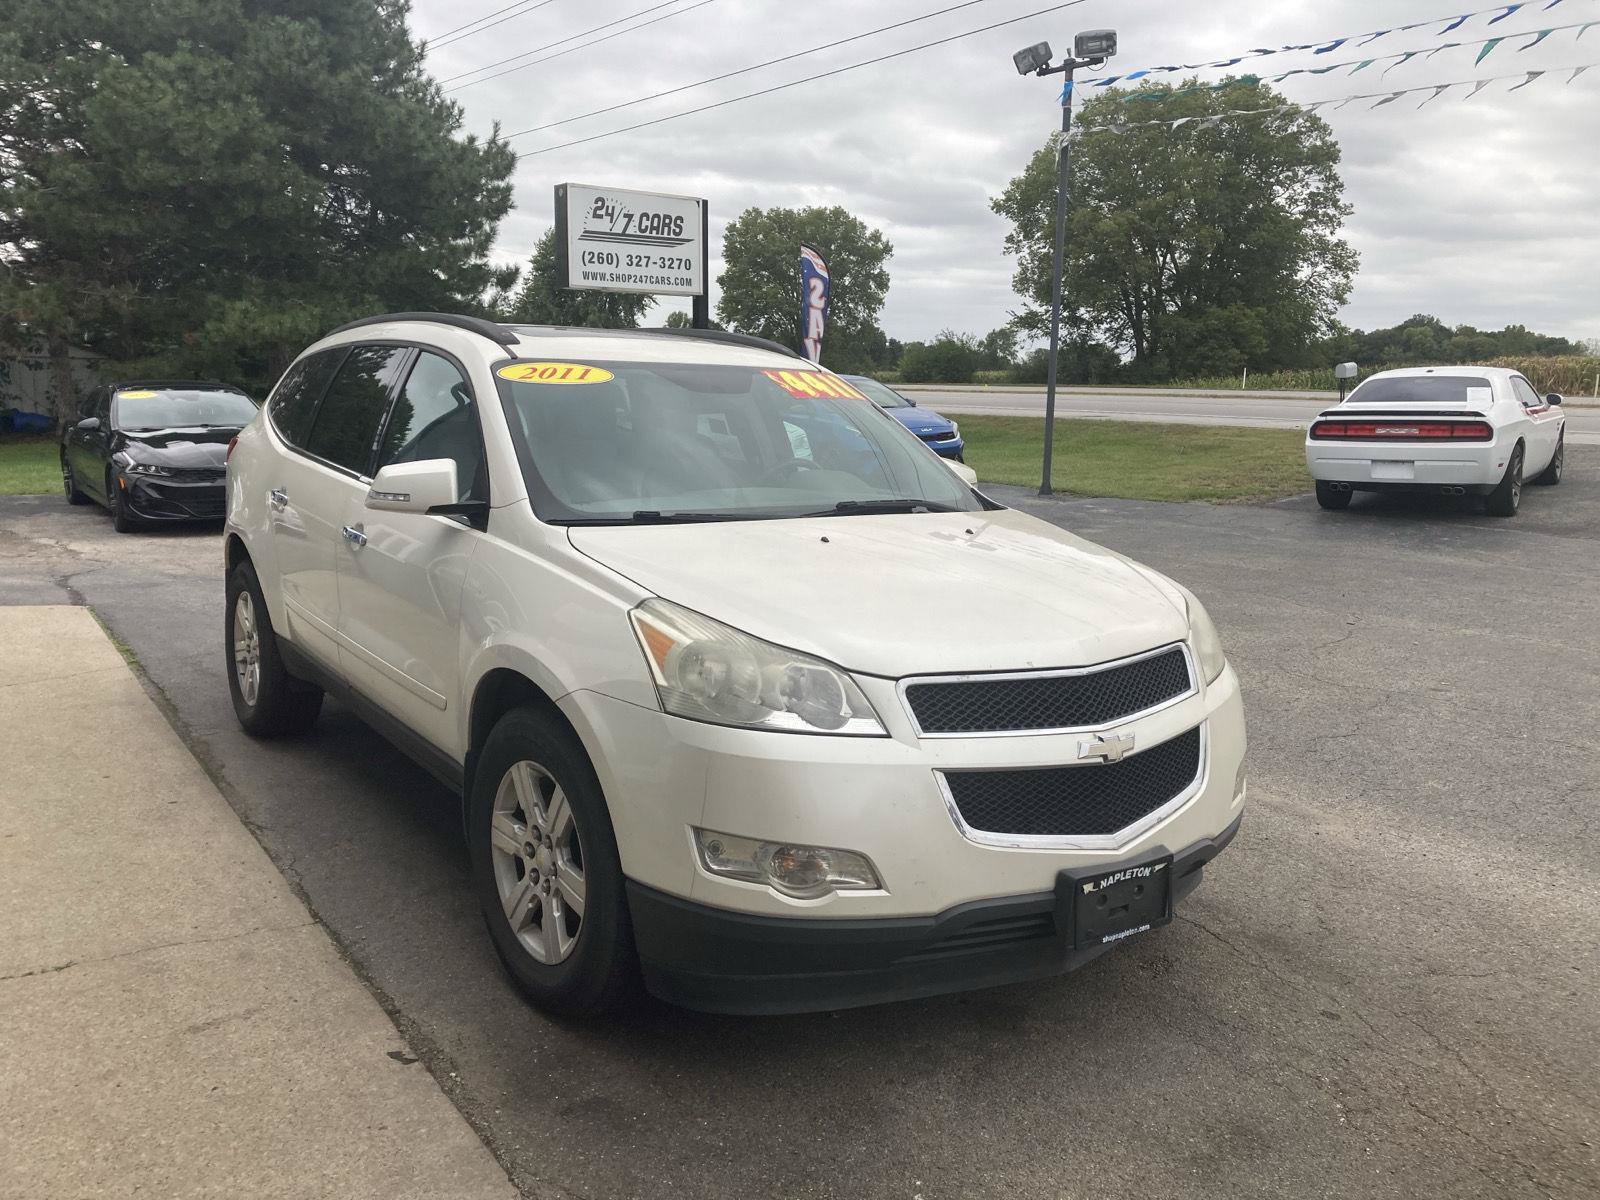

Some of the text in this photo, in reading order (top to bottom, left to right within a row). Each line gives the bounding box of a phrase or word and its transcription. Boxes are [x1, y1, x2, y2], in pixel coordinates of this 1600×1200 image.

[592, 196, 684, 236] 24/7 CARS
[581, 250, 692, 271] (260) 327-3270
[582, 270, 692, 287] WWW.SHOP247CARS.COM
[518, 367, 592, 380] 2011
[1100, 867, 1152, 889] NAPLETON
